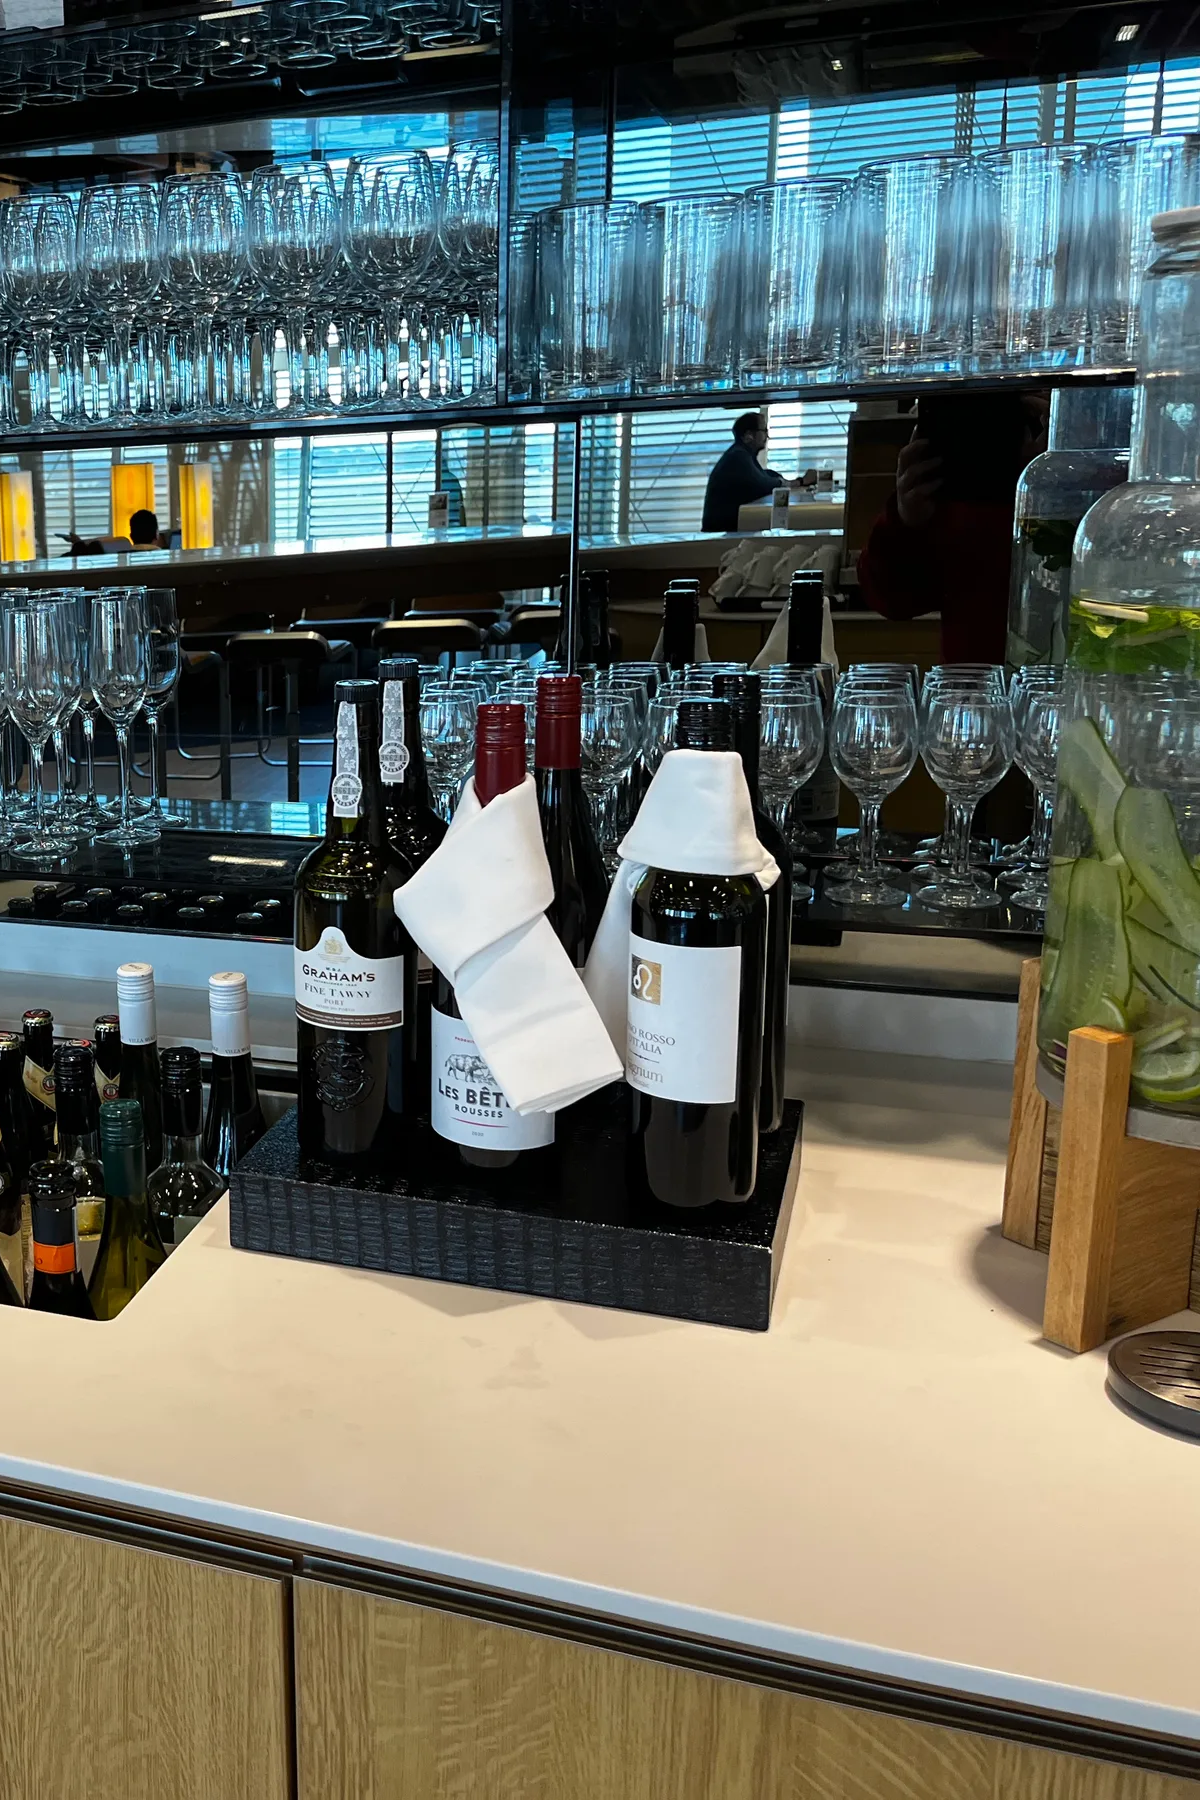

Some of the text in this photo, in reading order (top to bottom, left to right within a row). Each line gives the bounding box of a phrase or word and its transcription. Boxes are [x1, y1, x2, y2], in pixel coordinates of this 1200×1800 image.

[302, 964, 376, 982] GRAHAM'S
[304, 982, 372, 999] FINE TAWNY
[324, 998, 344, 1006] PORT
[638, 1028, 676, 1046] ROSSO
[438, 1077, 459, 1101] LES
[454, 1103, 503, 1118] ROUSSES
